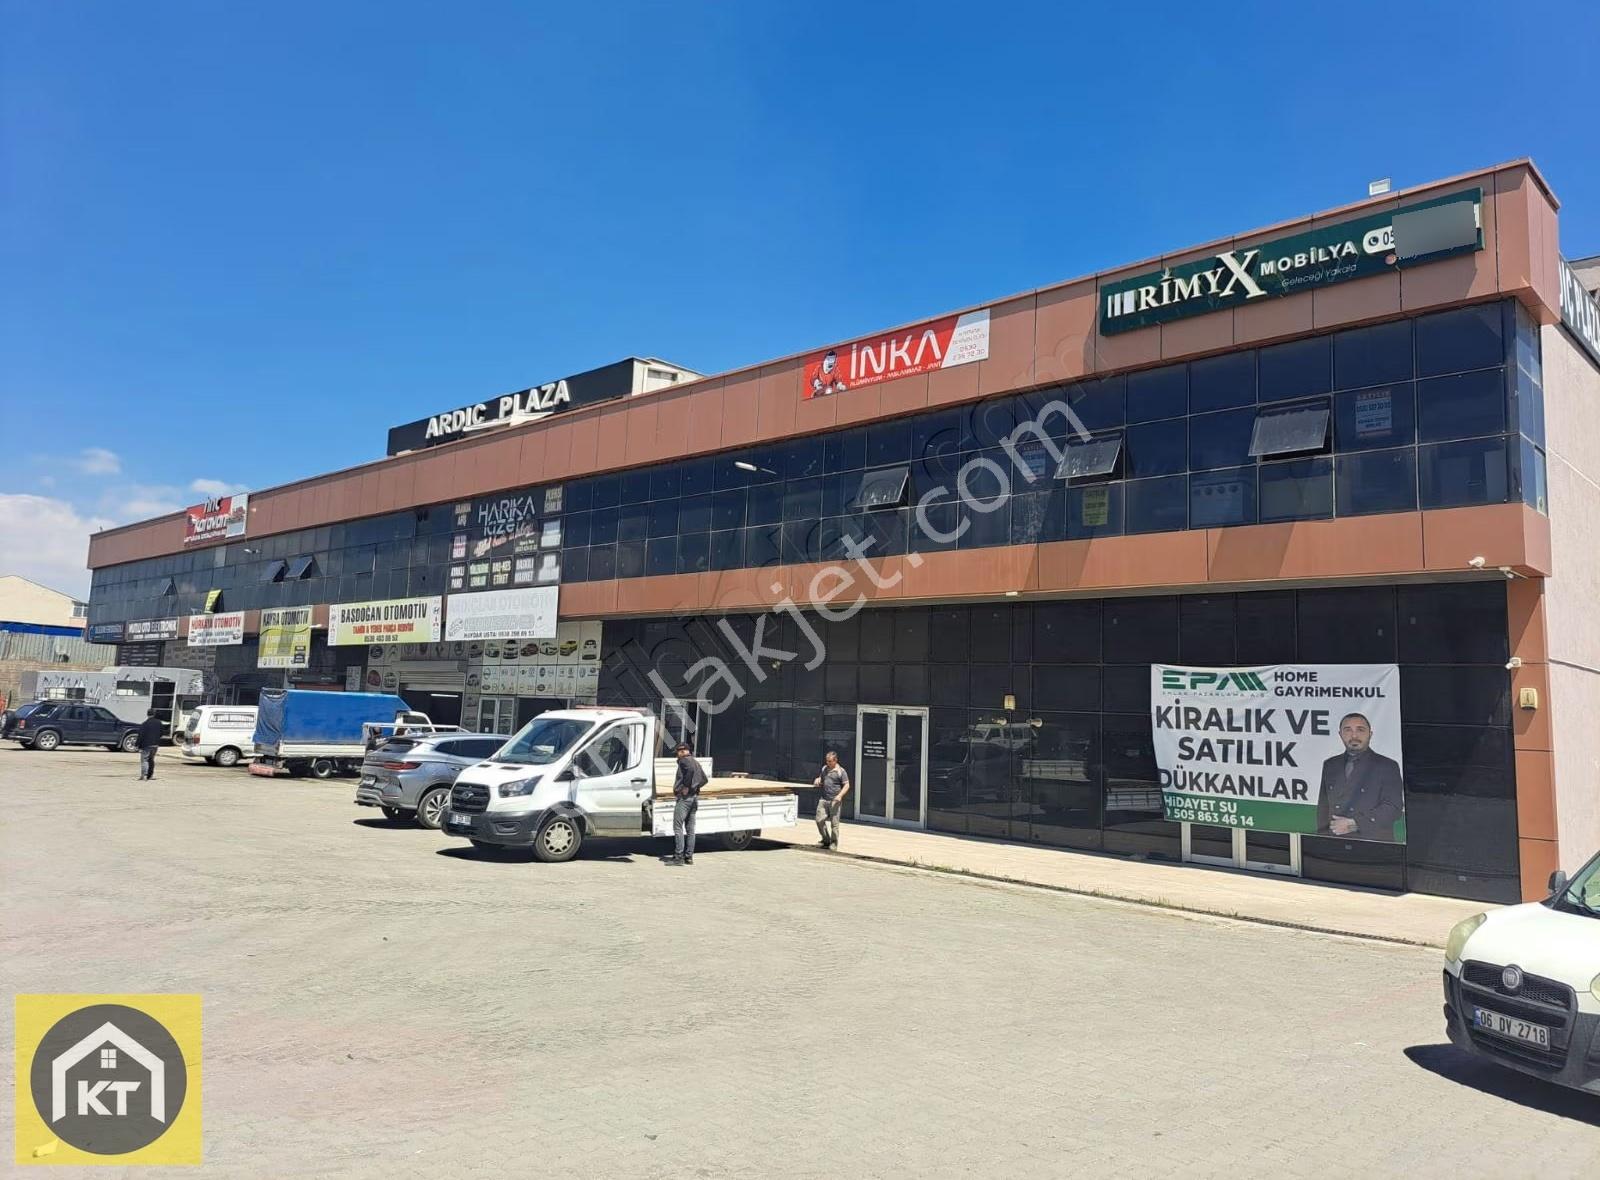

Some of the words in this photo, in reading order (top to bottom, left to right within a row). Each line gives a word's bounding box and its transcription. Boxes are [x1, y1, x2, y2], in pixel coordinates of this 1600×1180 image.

[1260, 241, 1358, 276] MOBİLYA
[850, 329, 941, 379] İNKA
[500, 380, 570, 419] PLAZA
[384, 603, 427, 621] OTOMOTİV
[1274, 672, 1318, 682] HOME
[1156, 698, 1276, 734] KİRALIK
[1286, 709, 1330, 735] VE
[1178, 737, 1298, 767] SATILIK
[1160, 765, 1308, 801] DÜKKANLAR
[1174, 809, 1195, 820] 505
[1198, 811, 1219, 822] 863
[1222, 814, 1238, 825] 46
[1240, 815, 1254, 826] 14
[1219, 801, 1237, 813] SU
[1480, 1011, 1493, 1027] 06
[1499, 1017, 1511, 1034] DV
[1518, 1023, 1546, 1043] 2718
